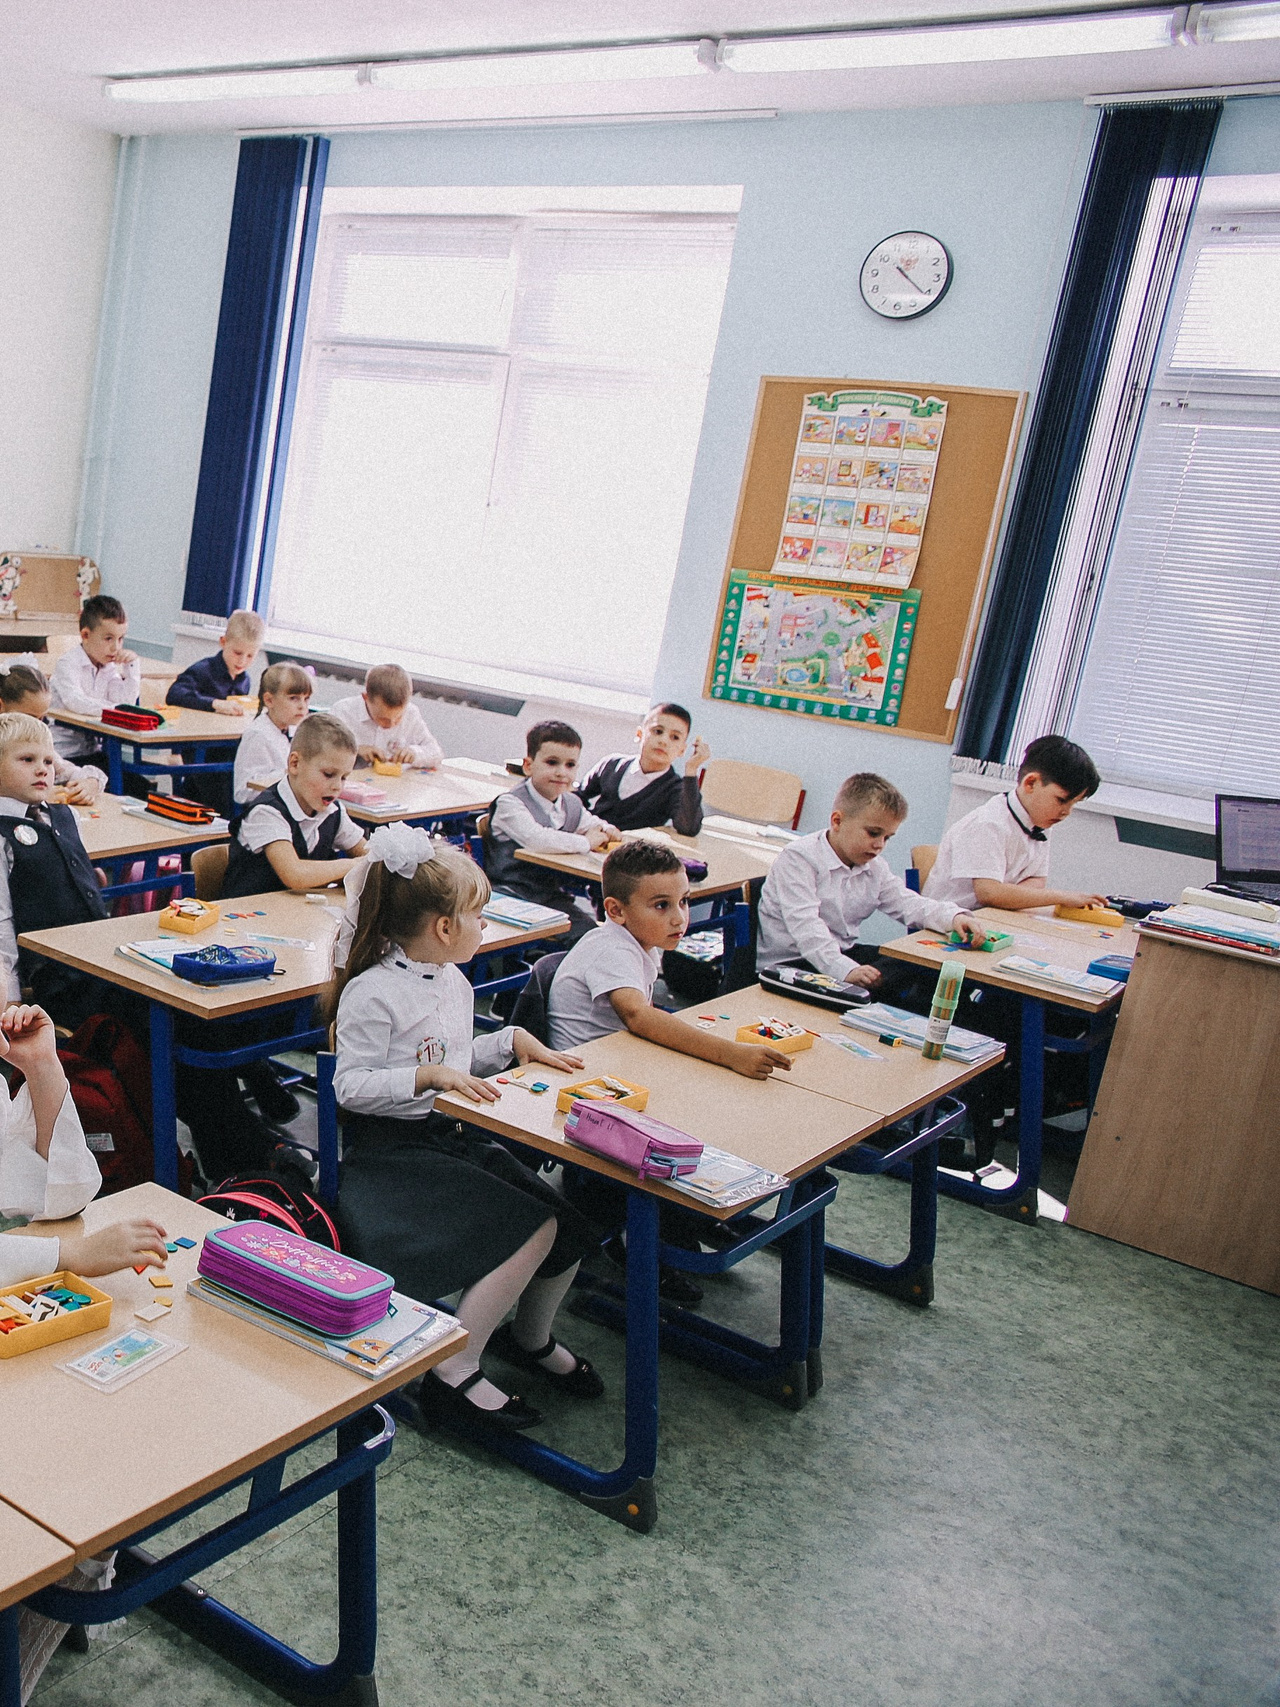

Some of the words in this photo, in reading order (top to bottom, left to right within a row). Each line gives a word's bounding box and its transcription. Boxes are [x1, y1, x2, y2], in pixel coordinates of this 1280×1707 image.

[932, 257, 940, 267] 2
[871, 268, 879, 278] 9
[932, 273, 941, 283] 3
[871, 285, 879, 293] 8
[893, 302, 902, 311] 6
[423, 1042, 438, 1062] 1Г
